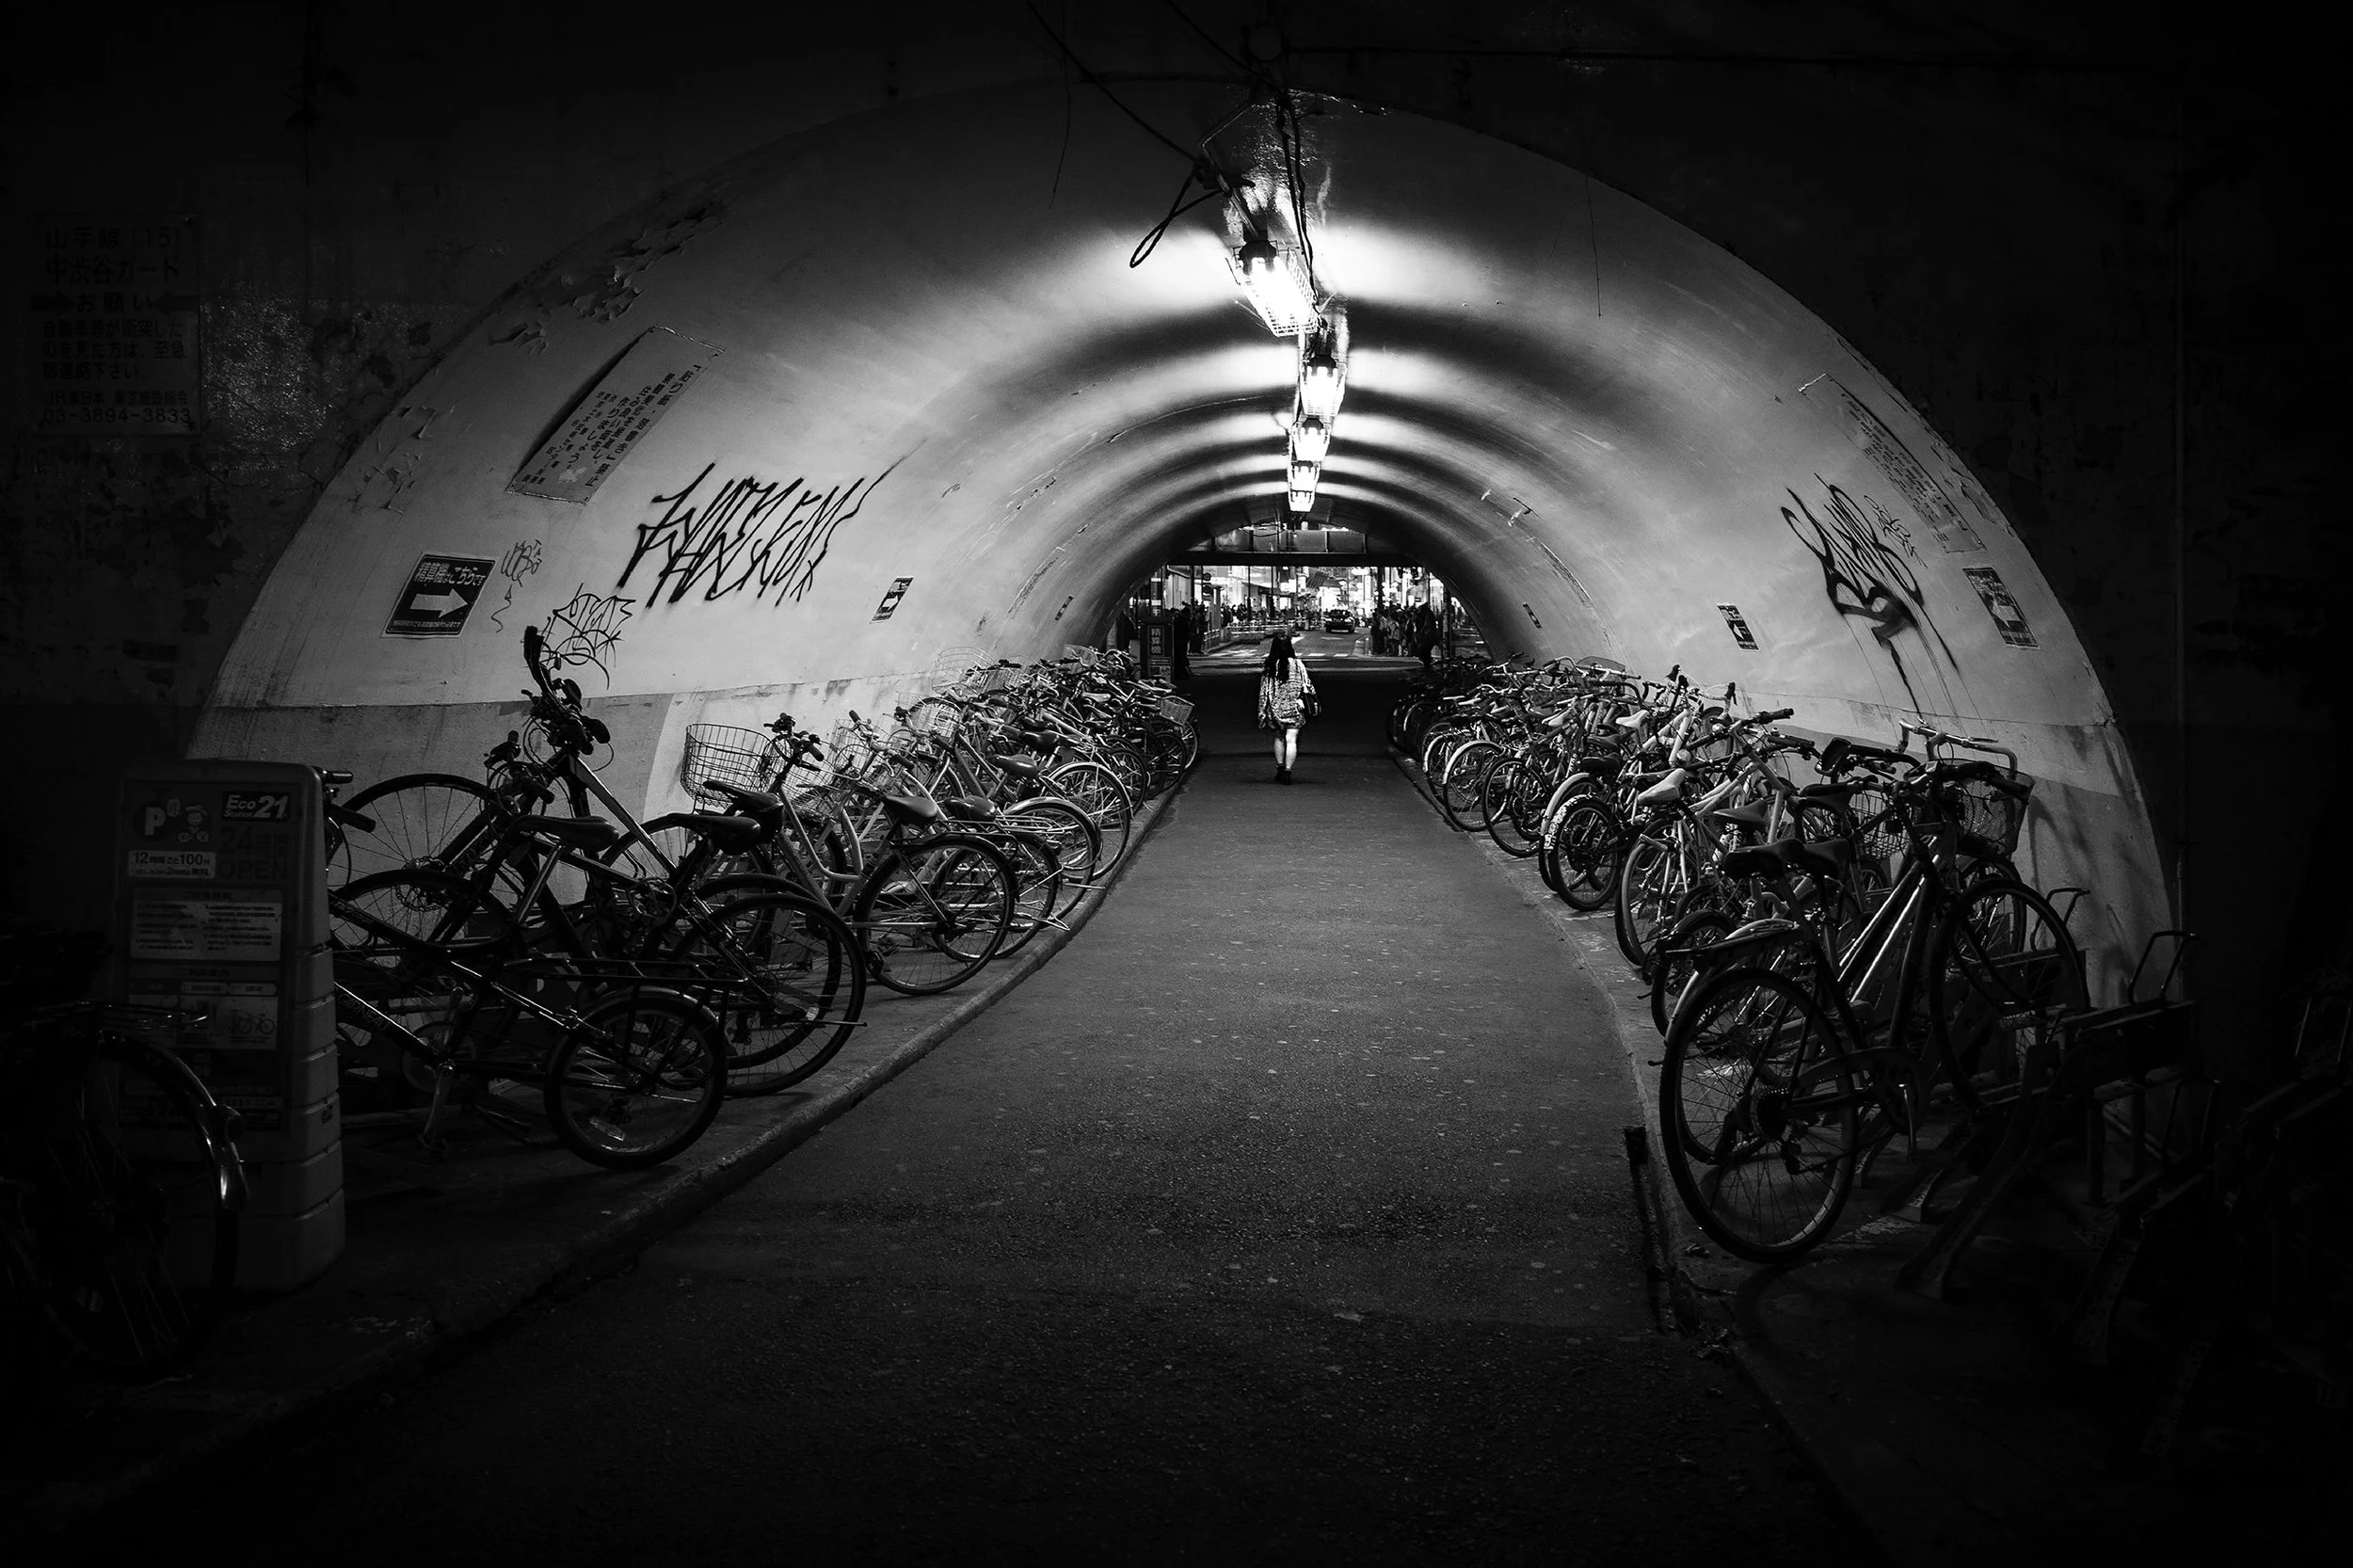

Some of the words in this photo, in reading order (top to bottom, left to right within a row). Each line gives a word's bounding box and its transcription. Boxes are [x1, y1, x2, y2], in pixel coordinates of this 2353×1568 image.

[46, 254, 181, 285] 中渋谷ガード
[42, 408, 192, 424] 03-3894-3833
[413, 561, 487, 585] 精算機はこちらです
[218, 857, 288, 879] OPEN
